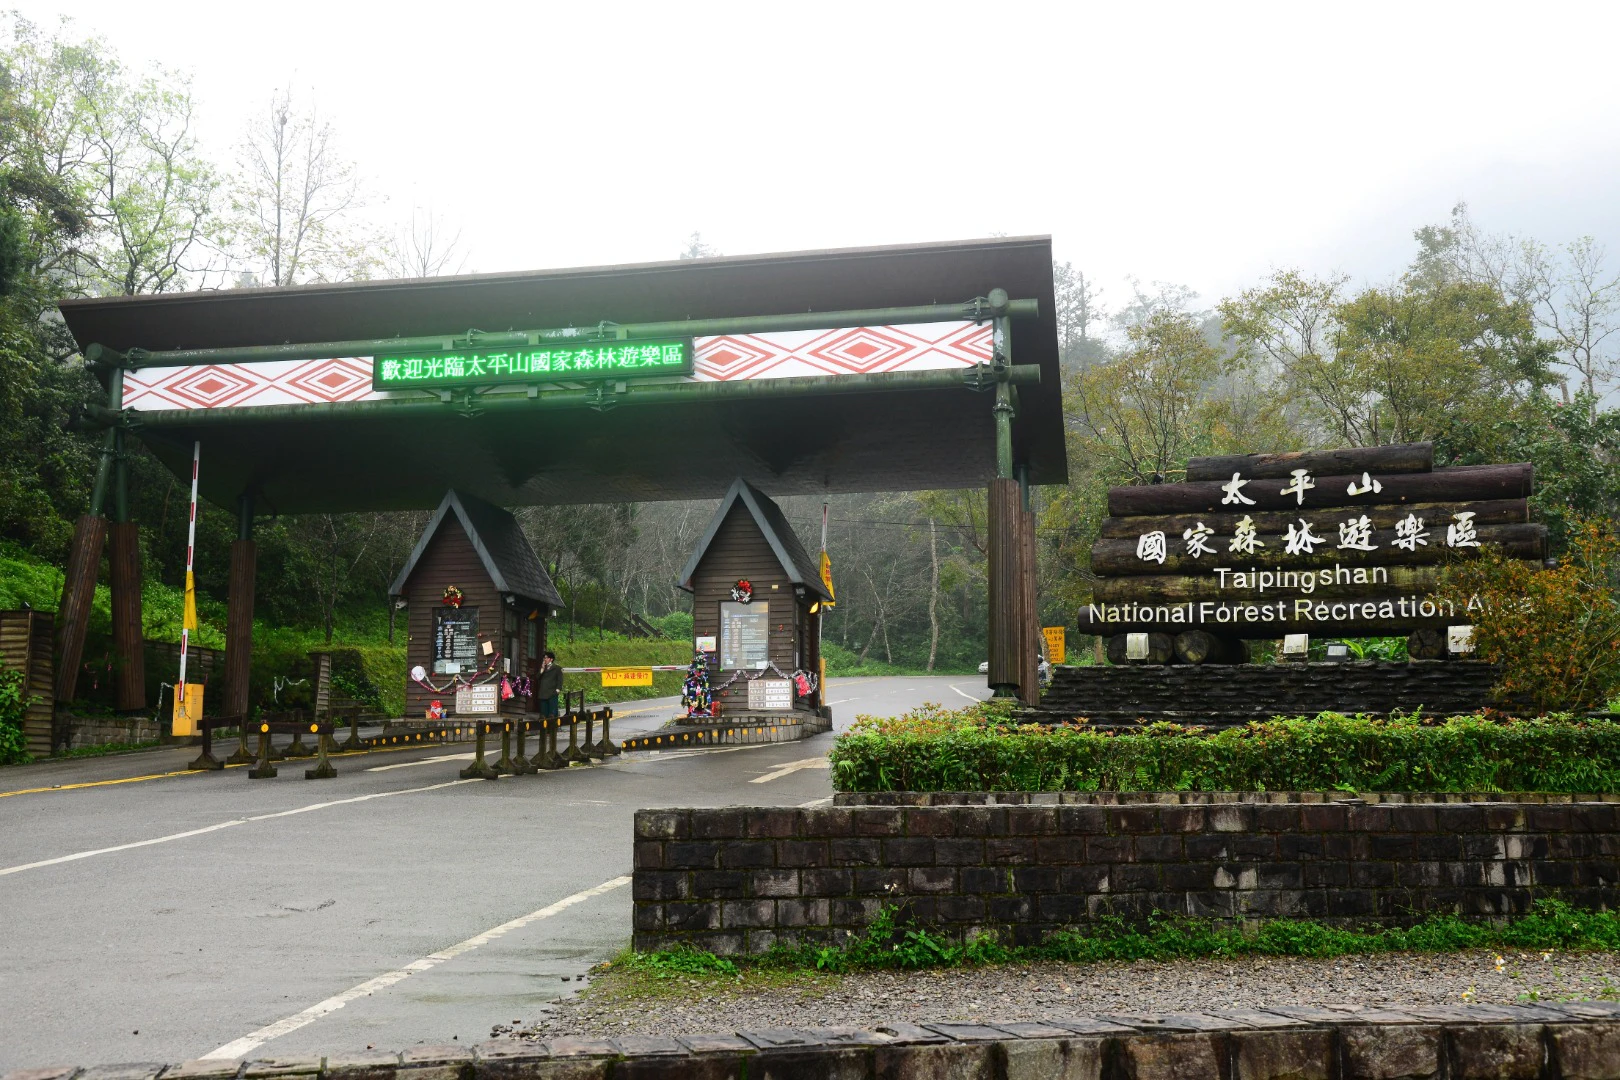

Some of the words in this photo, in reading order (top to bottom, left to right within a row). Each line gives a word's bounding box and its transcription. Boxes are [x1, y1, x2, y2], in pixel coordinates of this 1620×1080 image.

[381, 343, 684, 381] 歡迎光臨太平山國家森林遊樂區
[1221, 468, 1384, 506] 太平山
[1136, 511, 1482, 565] 國家森林遊樂區
[1213, 563, 1388, 594] Taipingshan
[1089, 601, 1193, 624] National
[1200, 601, 1287, 624] Forest
[1294, 595, 1455, 622] Recreation
